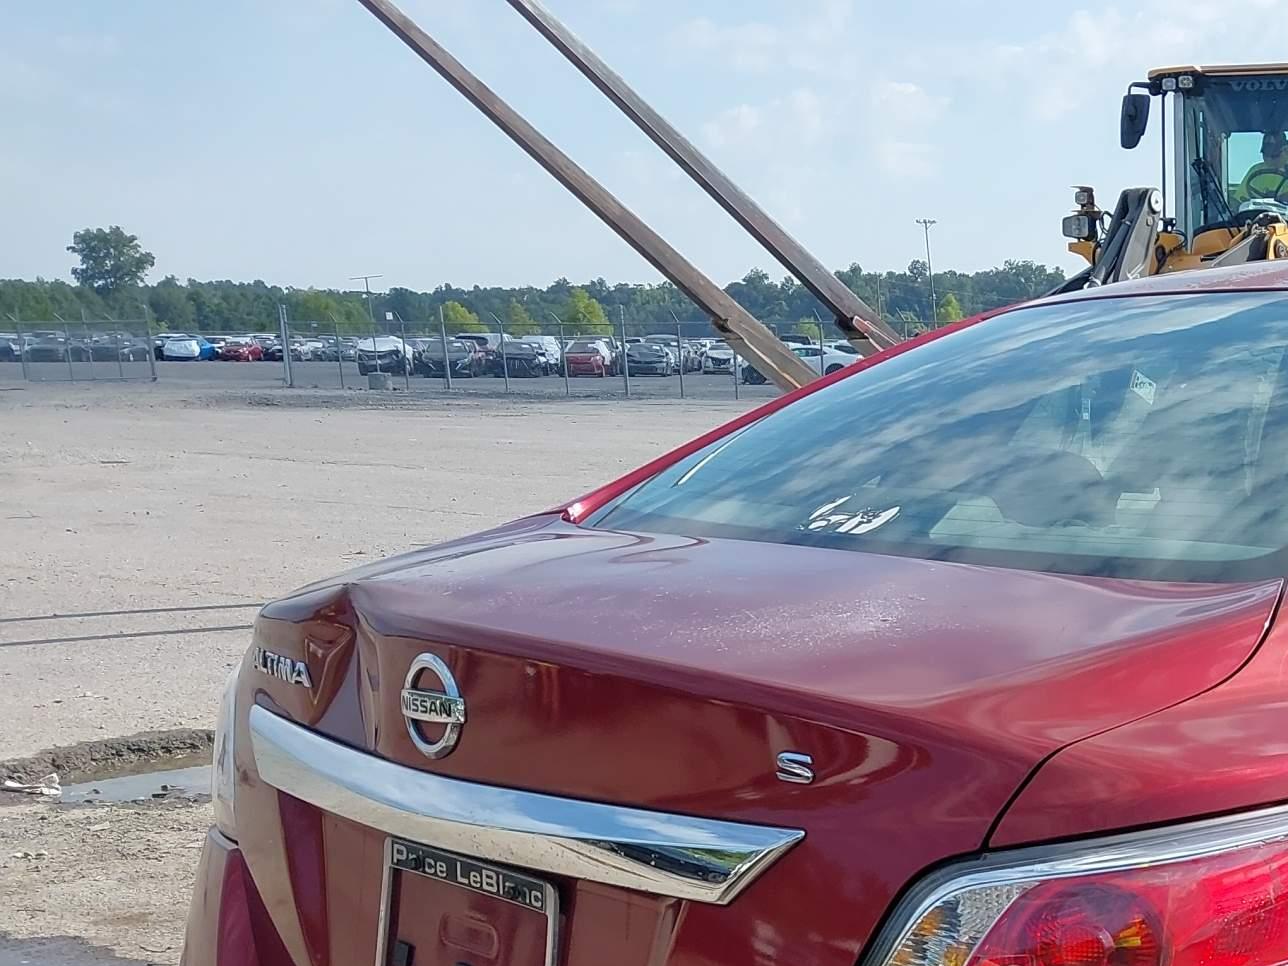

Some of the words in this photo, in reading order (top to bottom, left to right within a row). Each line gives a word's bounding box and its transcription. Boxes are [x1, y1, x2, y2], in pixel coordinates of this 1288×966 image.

[253, 647, 313, 688] ALTIMA
[401, 695, 451, 719] NISSAN
[775, 752, 814, 785] S
